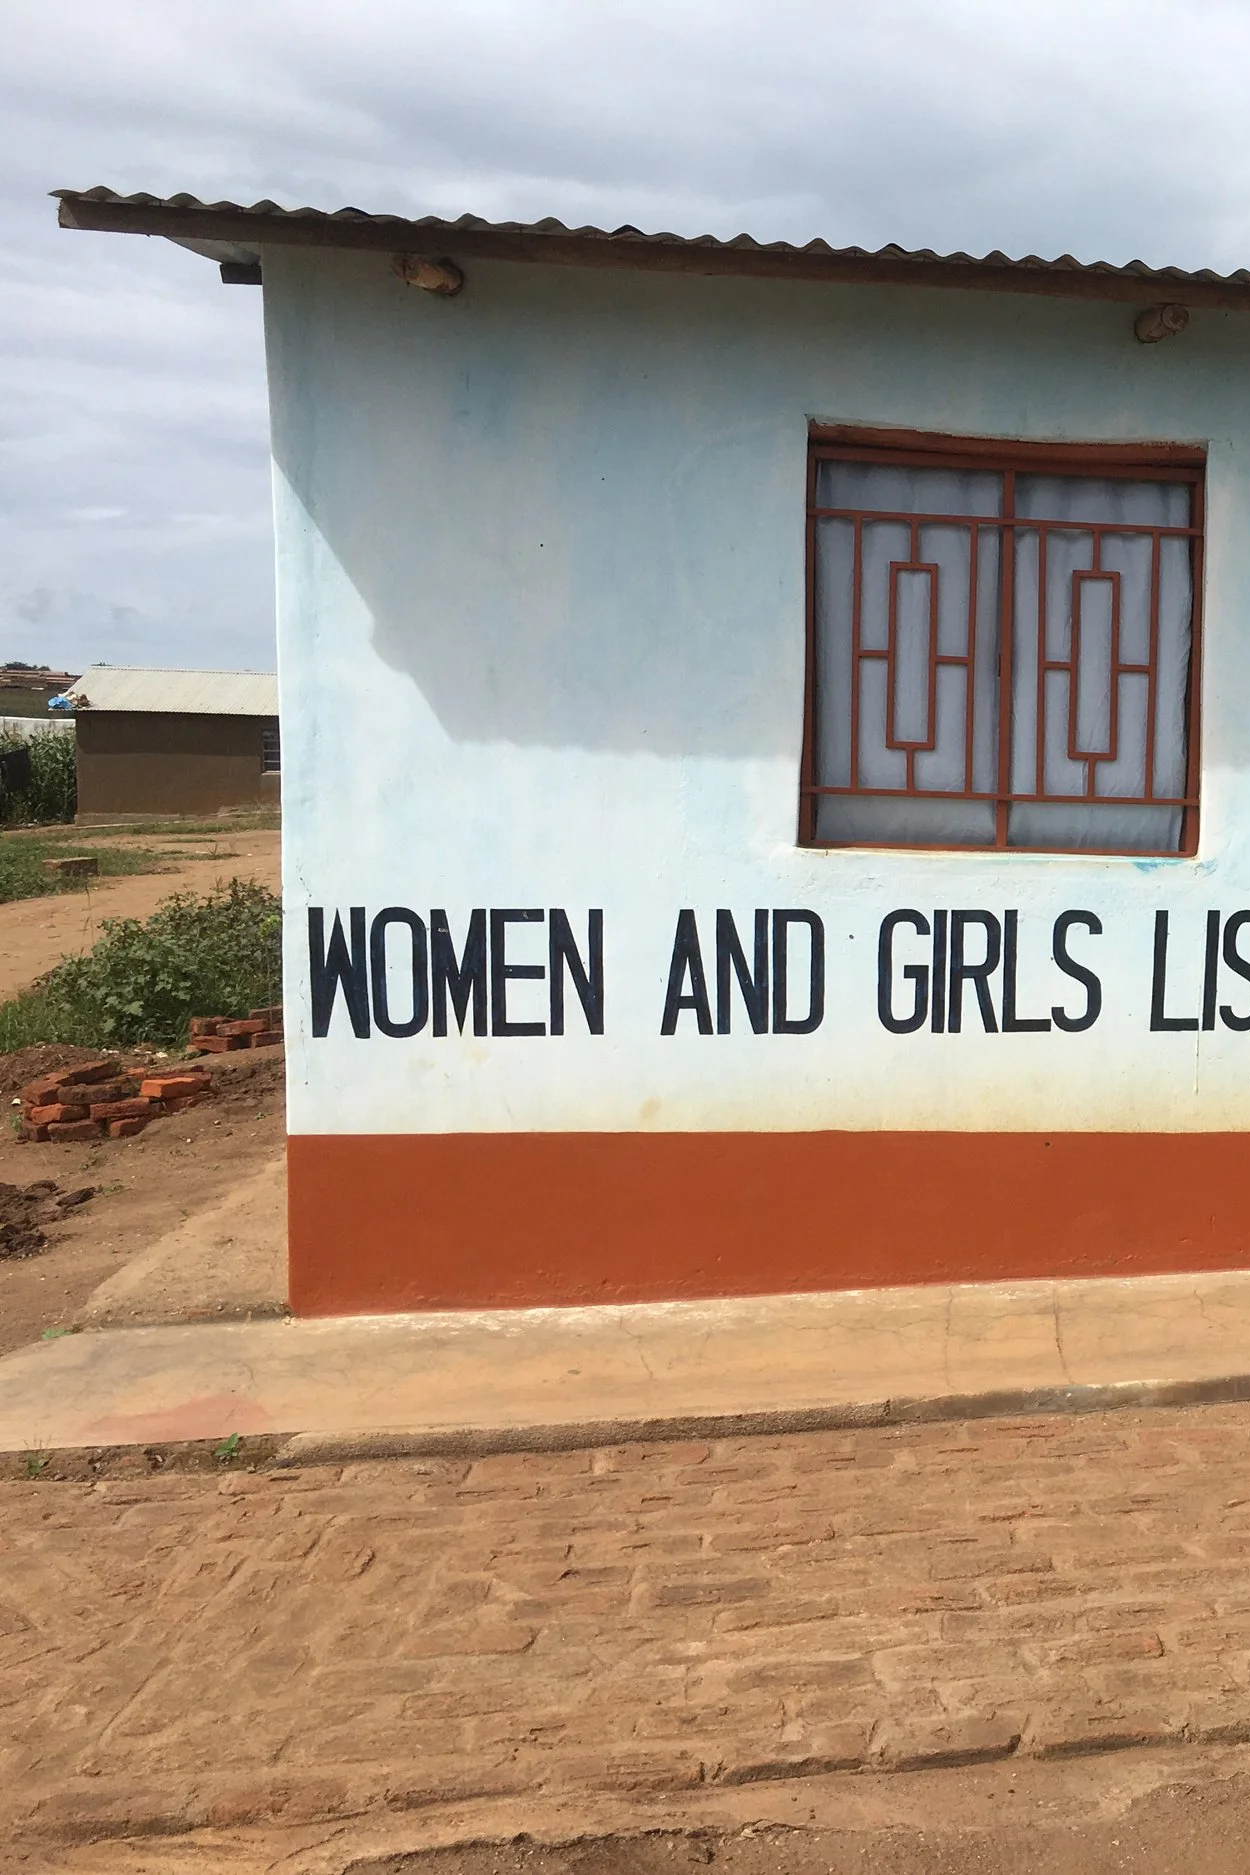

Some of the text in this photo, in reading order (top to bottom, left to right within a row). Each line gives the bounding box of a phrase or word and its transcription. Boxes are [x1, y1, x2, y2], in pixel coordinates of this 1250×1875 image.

[308, 907, 603, 1039] WOMEN
[661, 909, 824, 1035] AND
[878, 909, 1103, 1034] GIRLS
